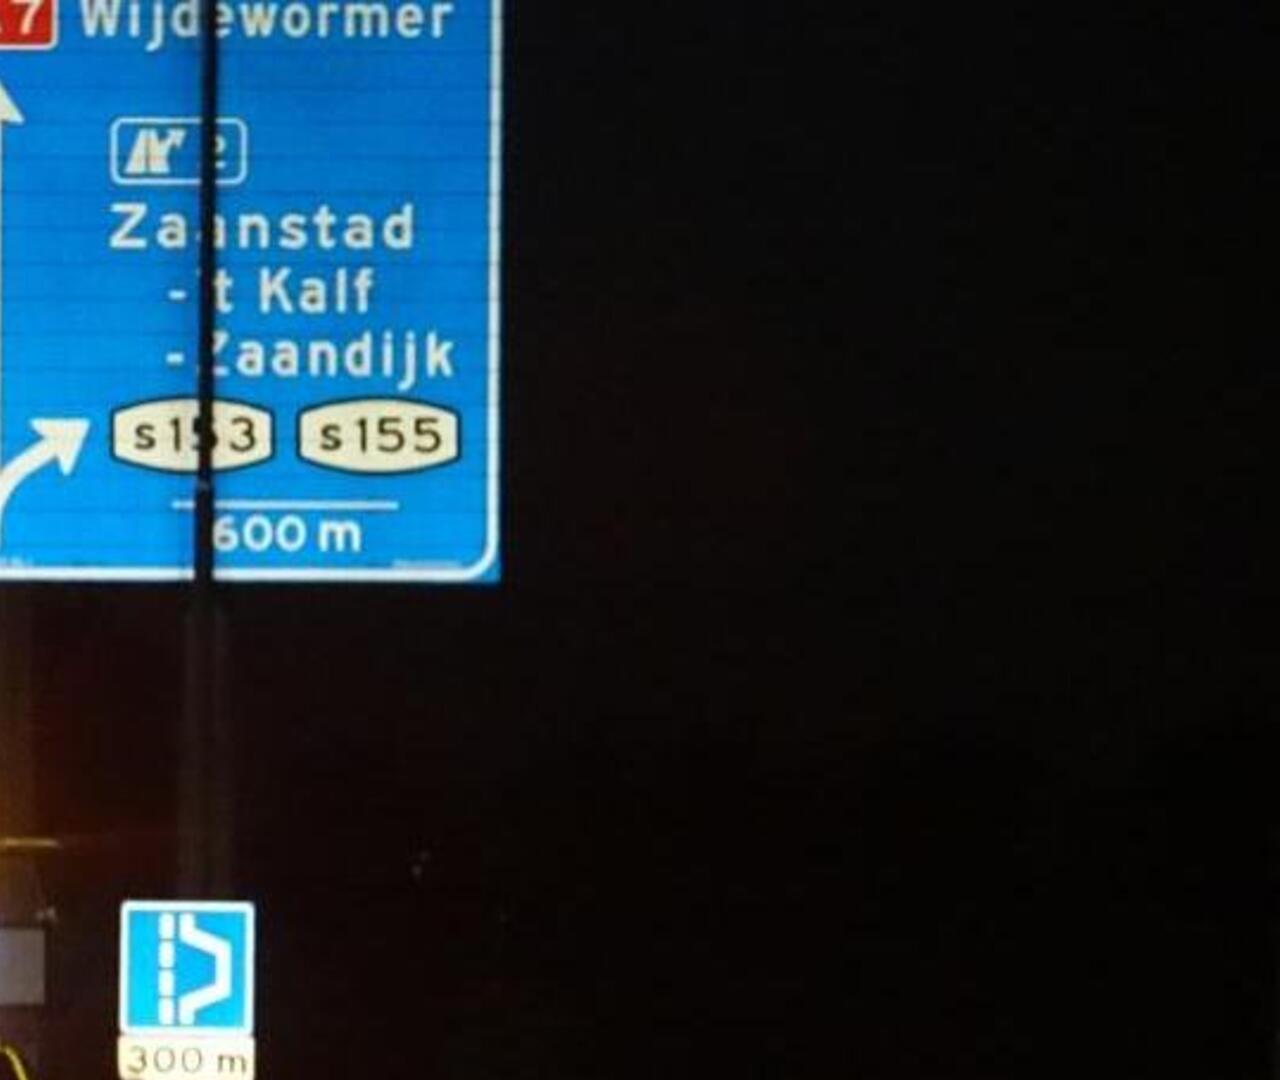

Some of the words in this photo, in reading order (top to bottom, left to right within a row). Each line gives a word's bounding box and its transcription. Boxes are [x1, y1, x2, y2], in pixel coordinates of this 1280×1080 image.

[259, 266, 374, 315] Kalf
[320, 416, 443, 453] s155
[211, 514, 307, 552] 600
[318, 519, 362, 552] m
[126, 1045, 203, 1075] 300
[216, 1053, 248, 1074] m
